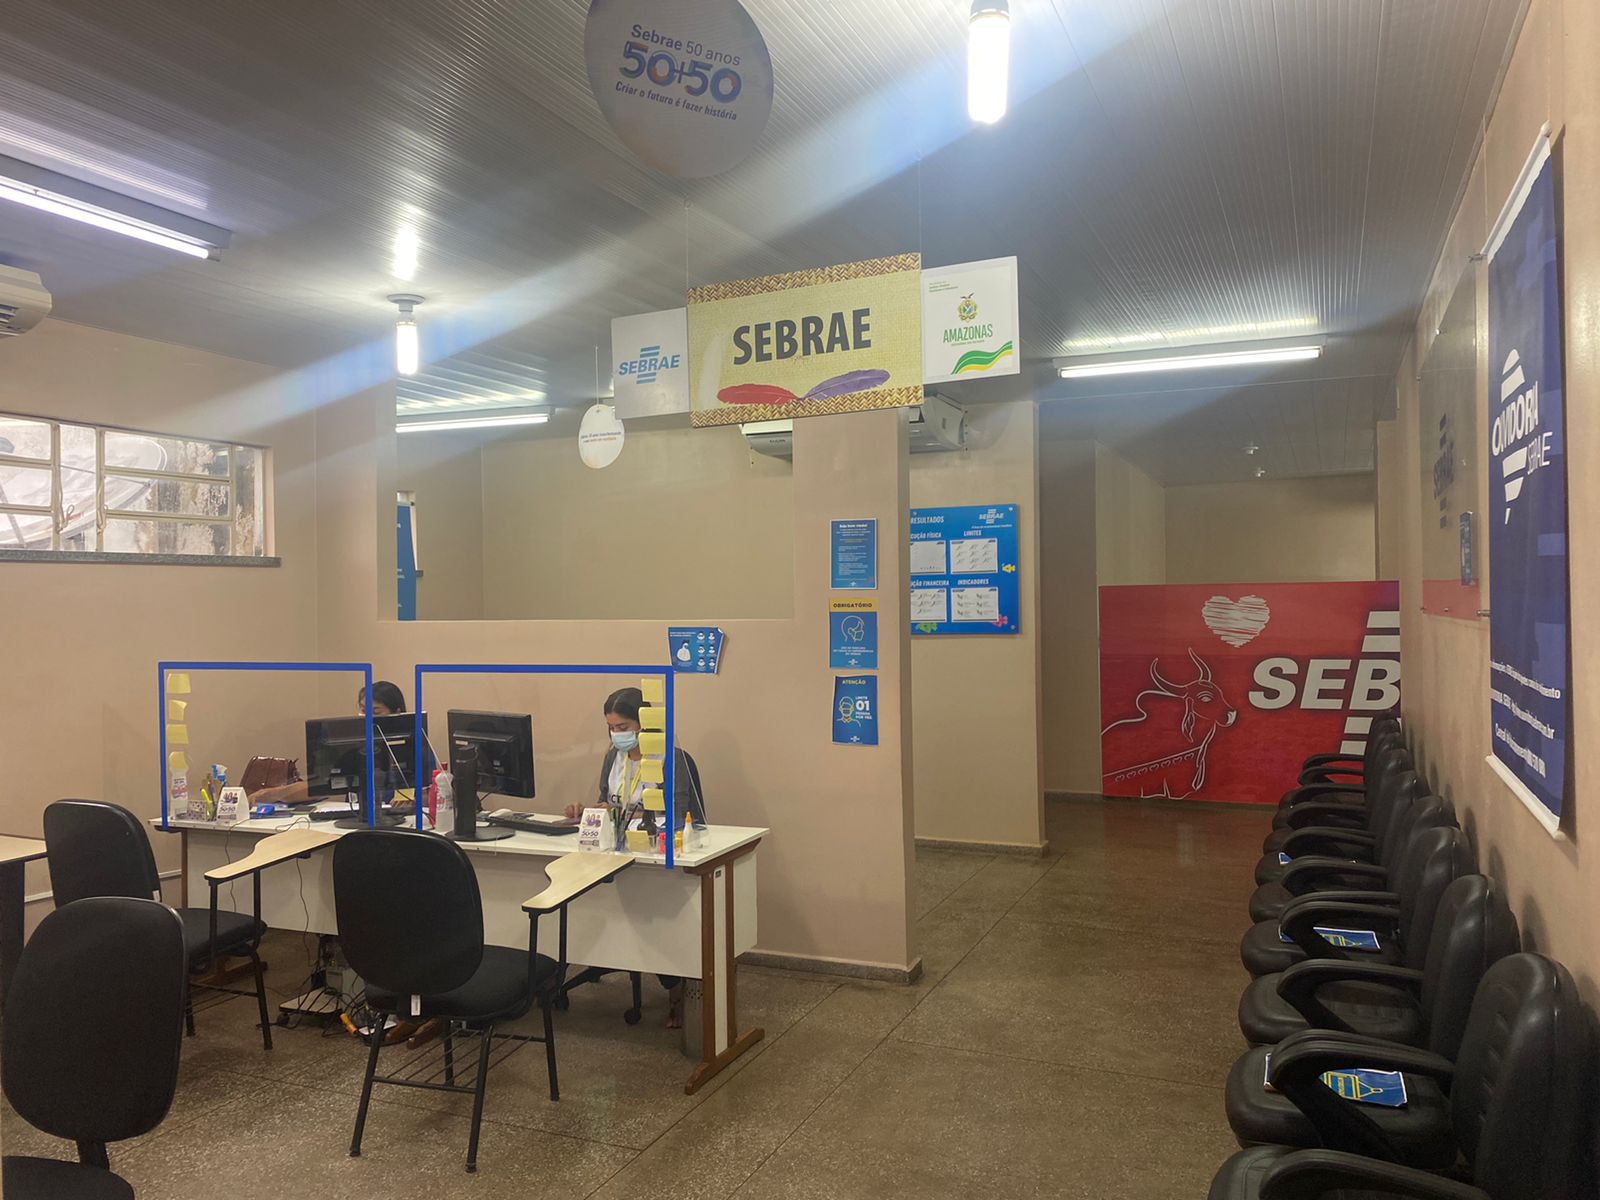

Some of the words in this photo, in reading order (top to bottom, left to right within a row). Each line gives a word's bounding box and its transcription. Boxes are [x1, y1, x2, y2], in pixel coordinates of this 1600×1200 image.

[631, 24, 683, 51] Sebrae
[685, 41, 703, 57] 50
[705, 49, 741, 66] anos
[619, 41, 742, 103] 50+50
[615, 80, 638, 96] Criar
[647, 90, 673, 105] futuro
[675, 97, 681, 106] é
[682, 99, 703, 114] fazer
[704, 104, 737, 120] história
[732, 307, 872, 366] SEBRAE
[943, 323, 993, 343] AMAZONAS
[618, 354, 681, 375] SEBRAE
[910, 516, 944, 525] RESULTADOS
[855, 700, 869, 711] 01
